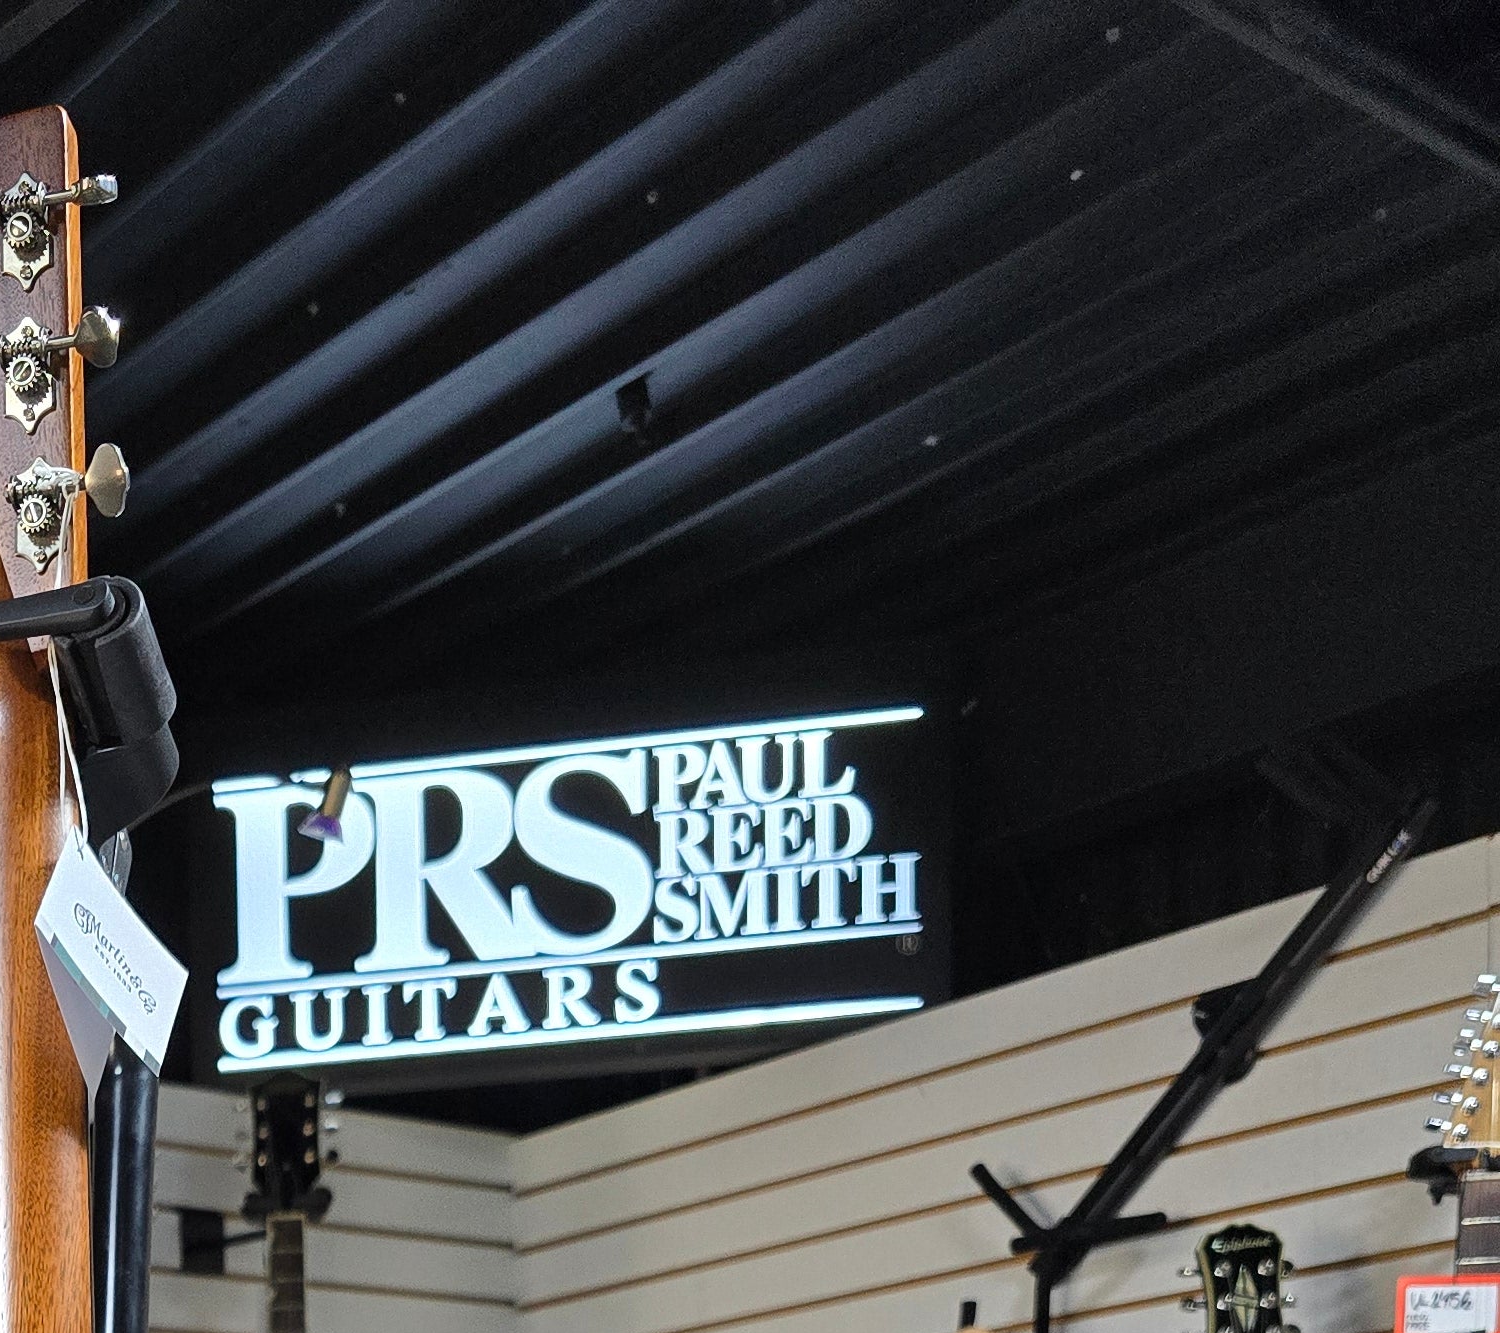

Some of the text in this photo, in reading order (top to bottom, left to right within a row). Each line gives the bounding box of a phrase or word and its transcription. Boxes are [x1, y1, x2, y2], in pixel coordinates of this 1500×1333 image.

[653, 730, 855, 815] PAUL
[214, 749, 654, 985] PRS
[655, 795, 872, 877] REED
[654, 853, 922, 943] SMITH
[219, 959, 662, 1058] GUITARS
